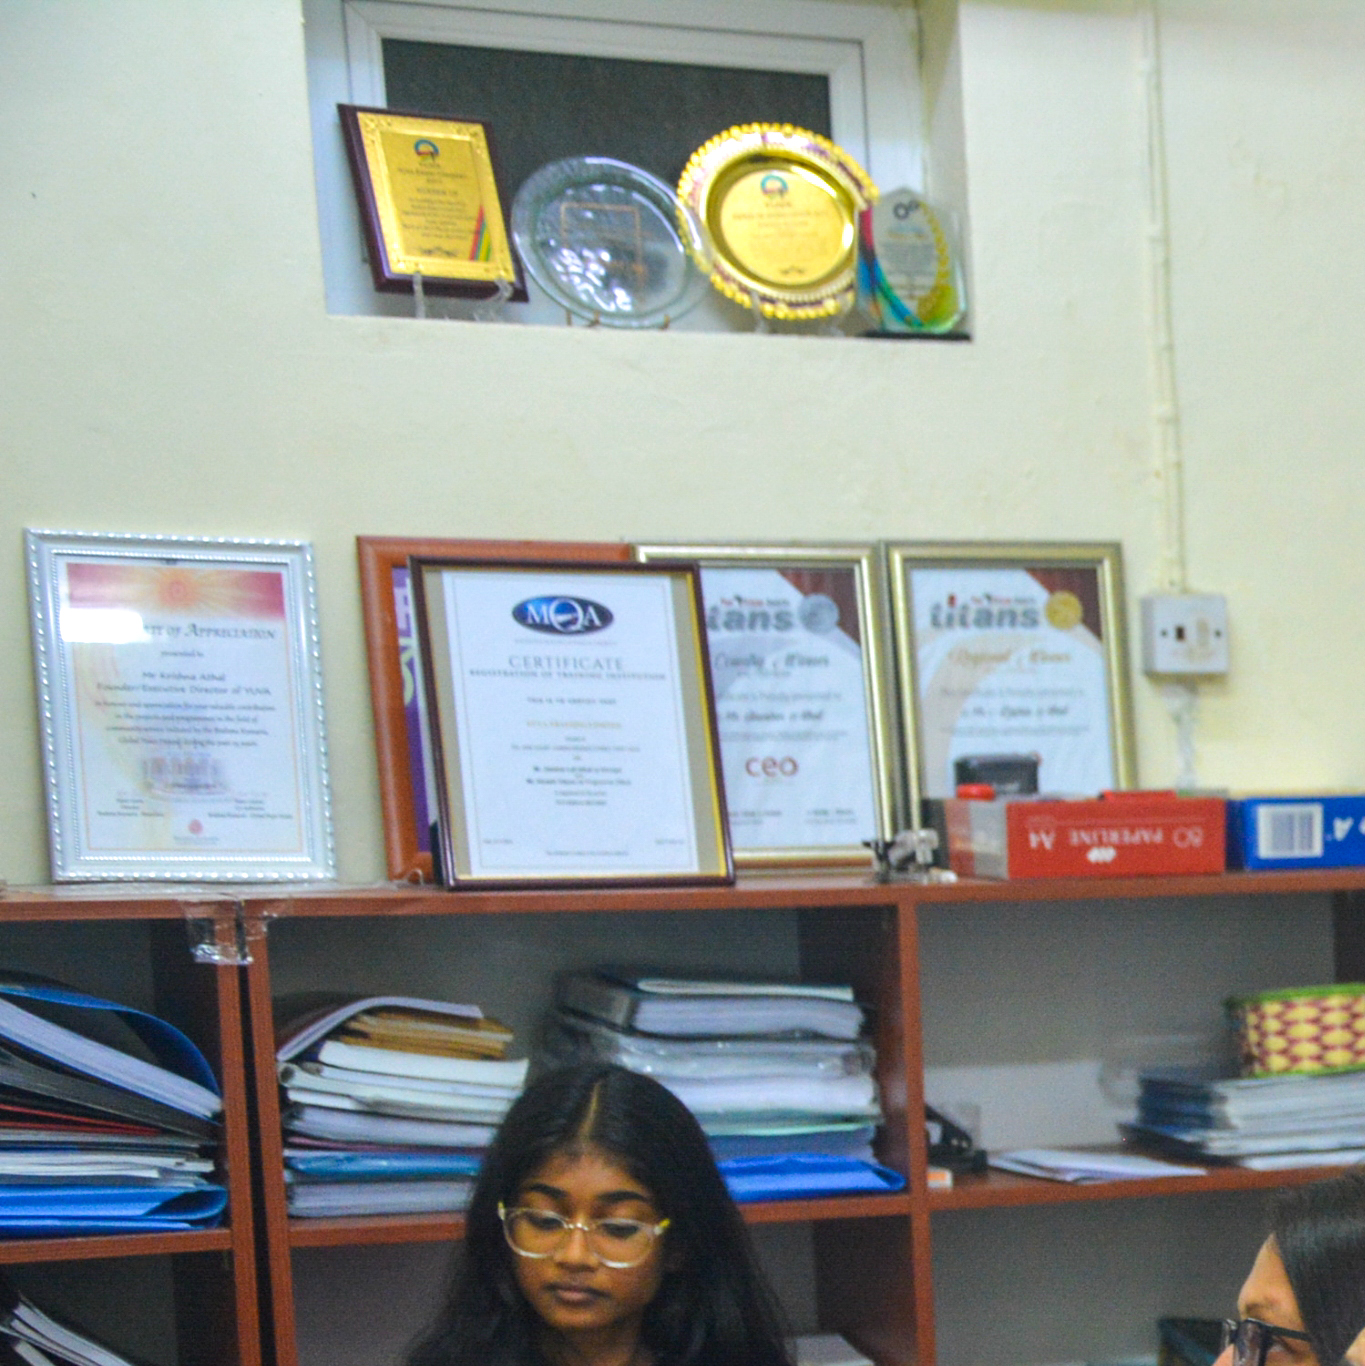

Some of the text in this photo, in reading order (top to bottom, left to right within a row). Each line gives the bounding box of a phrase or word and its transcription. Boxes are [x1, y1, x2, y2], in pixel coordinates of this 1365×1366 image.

[526, 598, 602, 634] MQA
[707, 603, 793, 631] tans
[931, 594, 1039, 630] titans
[508, 654, 624, 671] CERTIFICATE
[744, 756, 799, 777] ceo
[1029, 830, 1055, 850] A4
[1069, 827, 1165, 846] PAPERLINE
[1333, 816, 1354, 842] A
